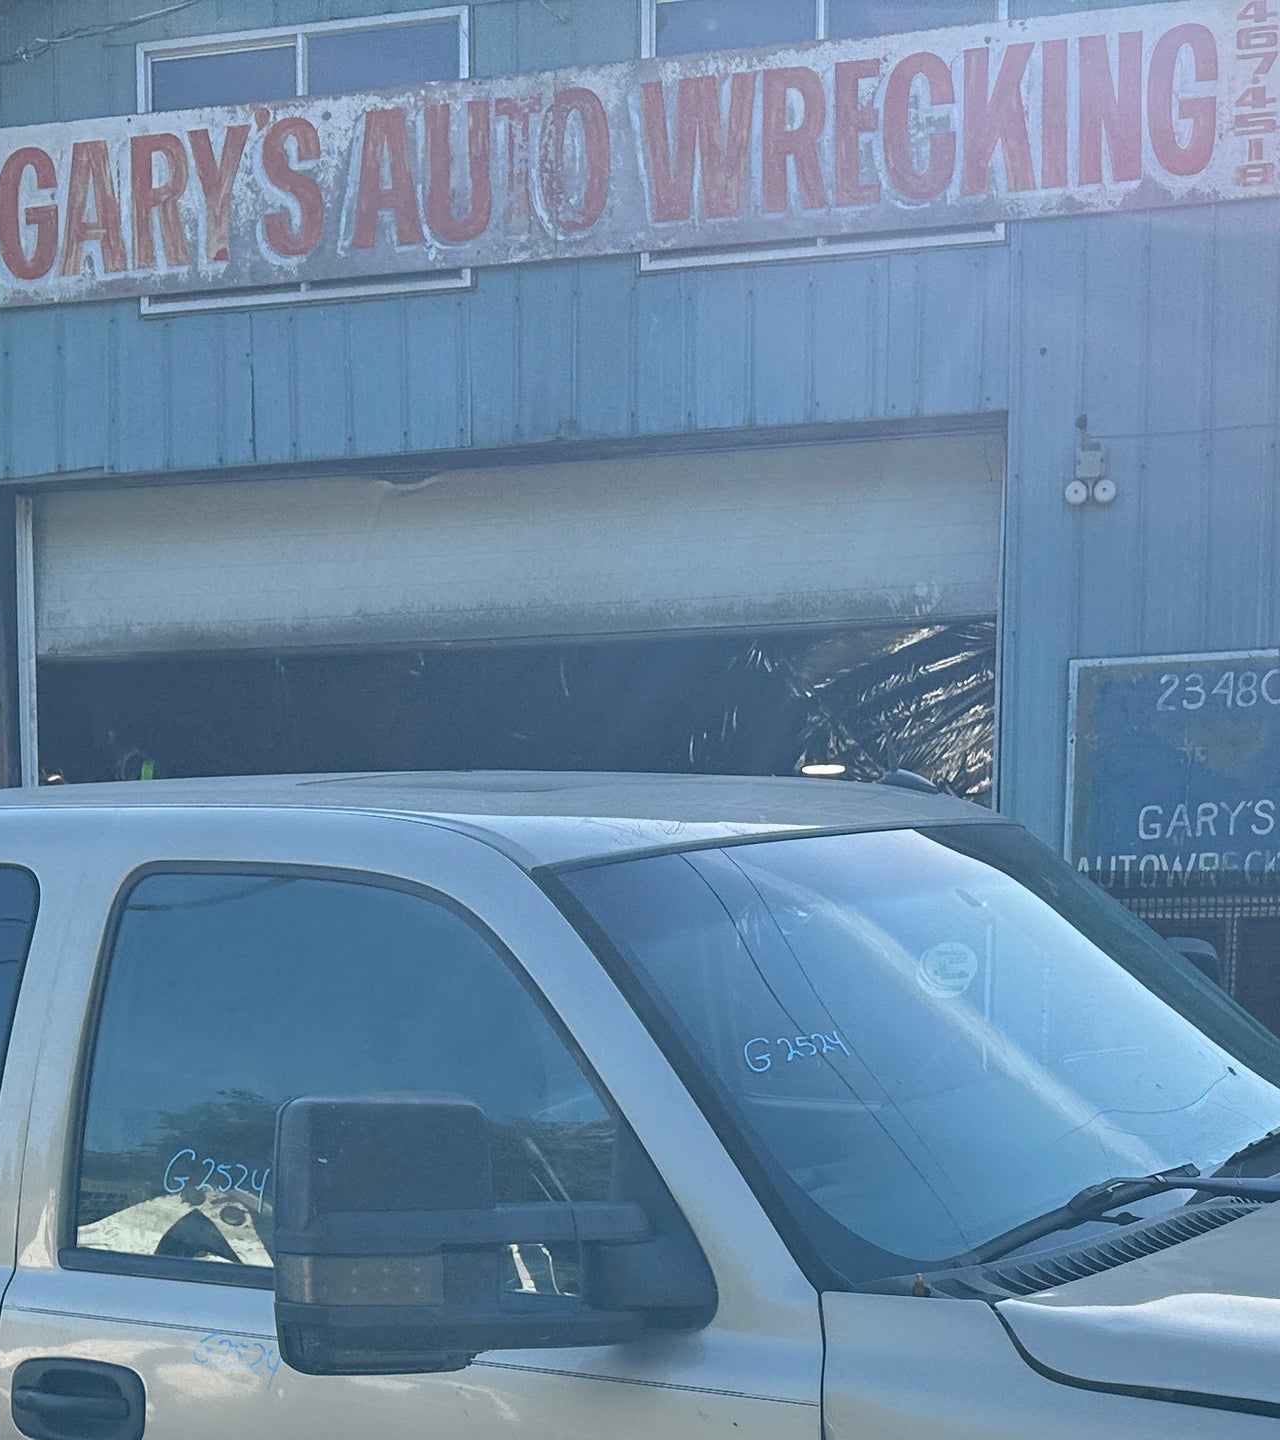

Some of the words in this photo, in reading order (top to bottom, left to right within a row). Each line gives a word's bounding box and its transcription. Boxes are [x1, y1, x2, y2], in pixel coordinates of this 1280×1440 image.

[353, 86, 610, 249] AUTO
[641, 22, 1218, 221] WRECKING
[1138, 800, 1275, 841] GARY'S
[163, 1148, 272, 1214] G2524
